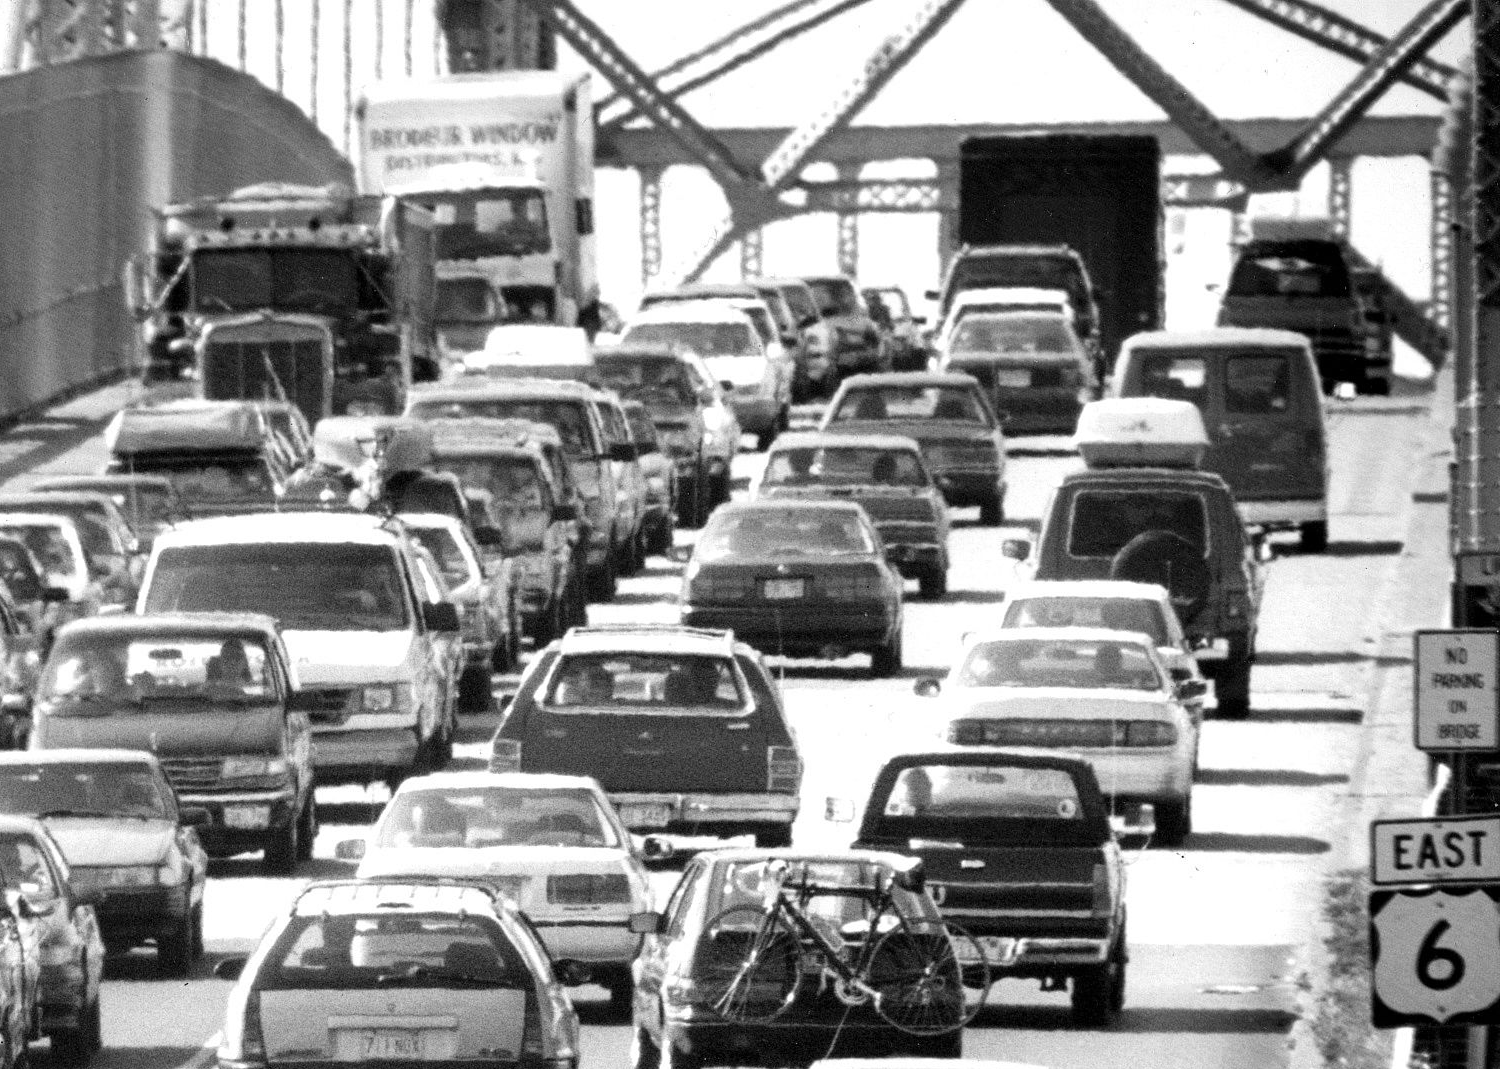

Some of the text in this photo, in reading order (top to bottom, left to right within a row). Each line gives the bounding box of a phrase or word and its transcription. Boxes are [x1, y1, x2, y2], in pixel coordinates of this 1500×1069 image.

[470, 122, 558, 145] WINDOW
[1445, 646, 1468, 665] NO
[1430, 671, 1484, 689] PARKING
[1448, 700, 1468, 714] ON
[1437, 723, 1481, 739] BRIDGE
[1392, 831, 1487, 870] EAST
[1415, 919, 1466, 991] 6
